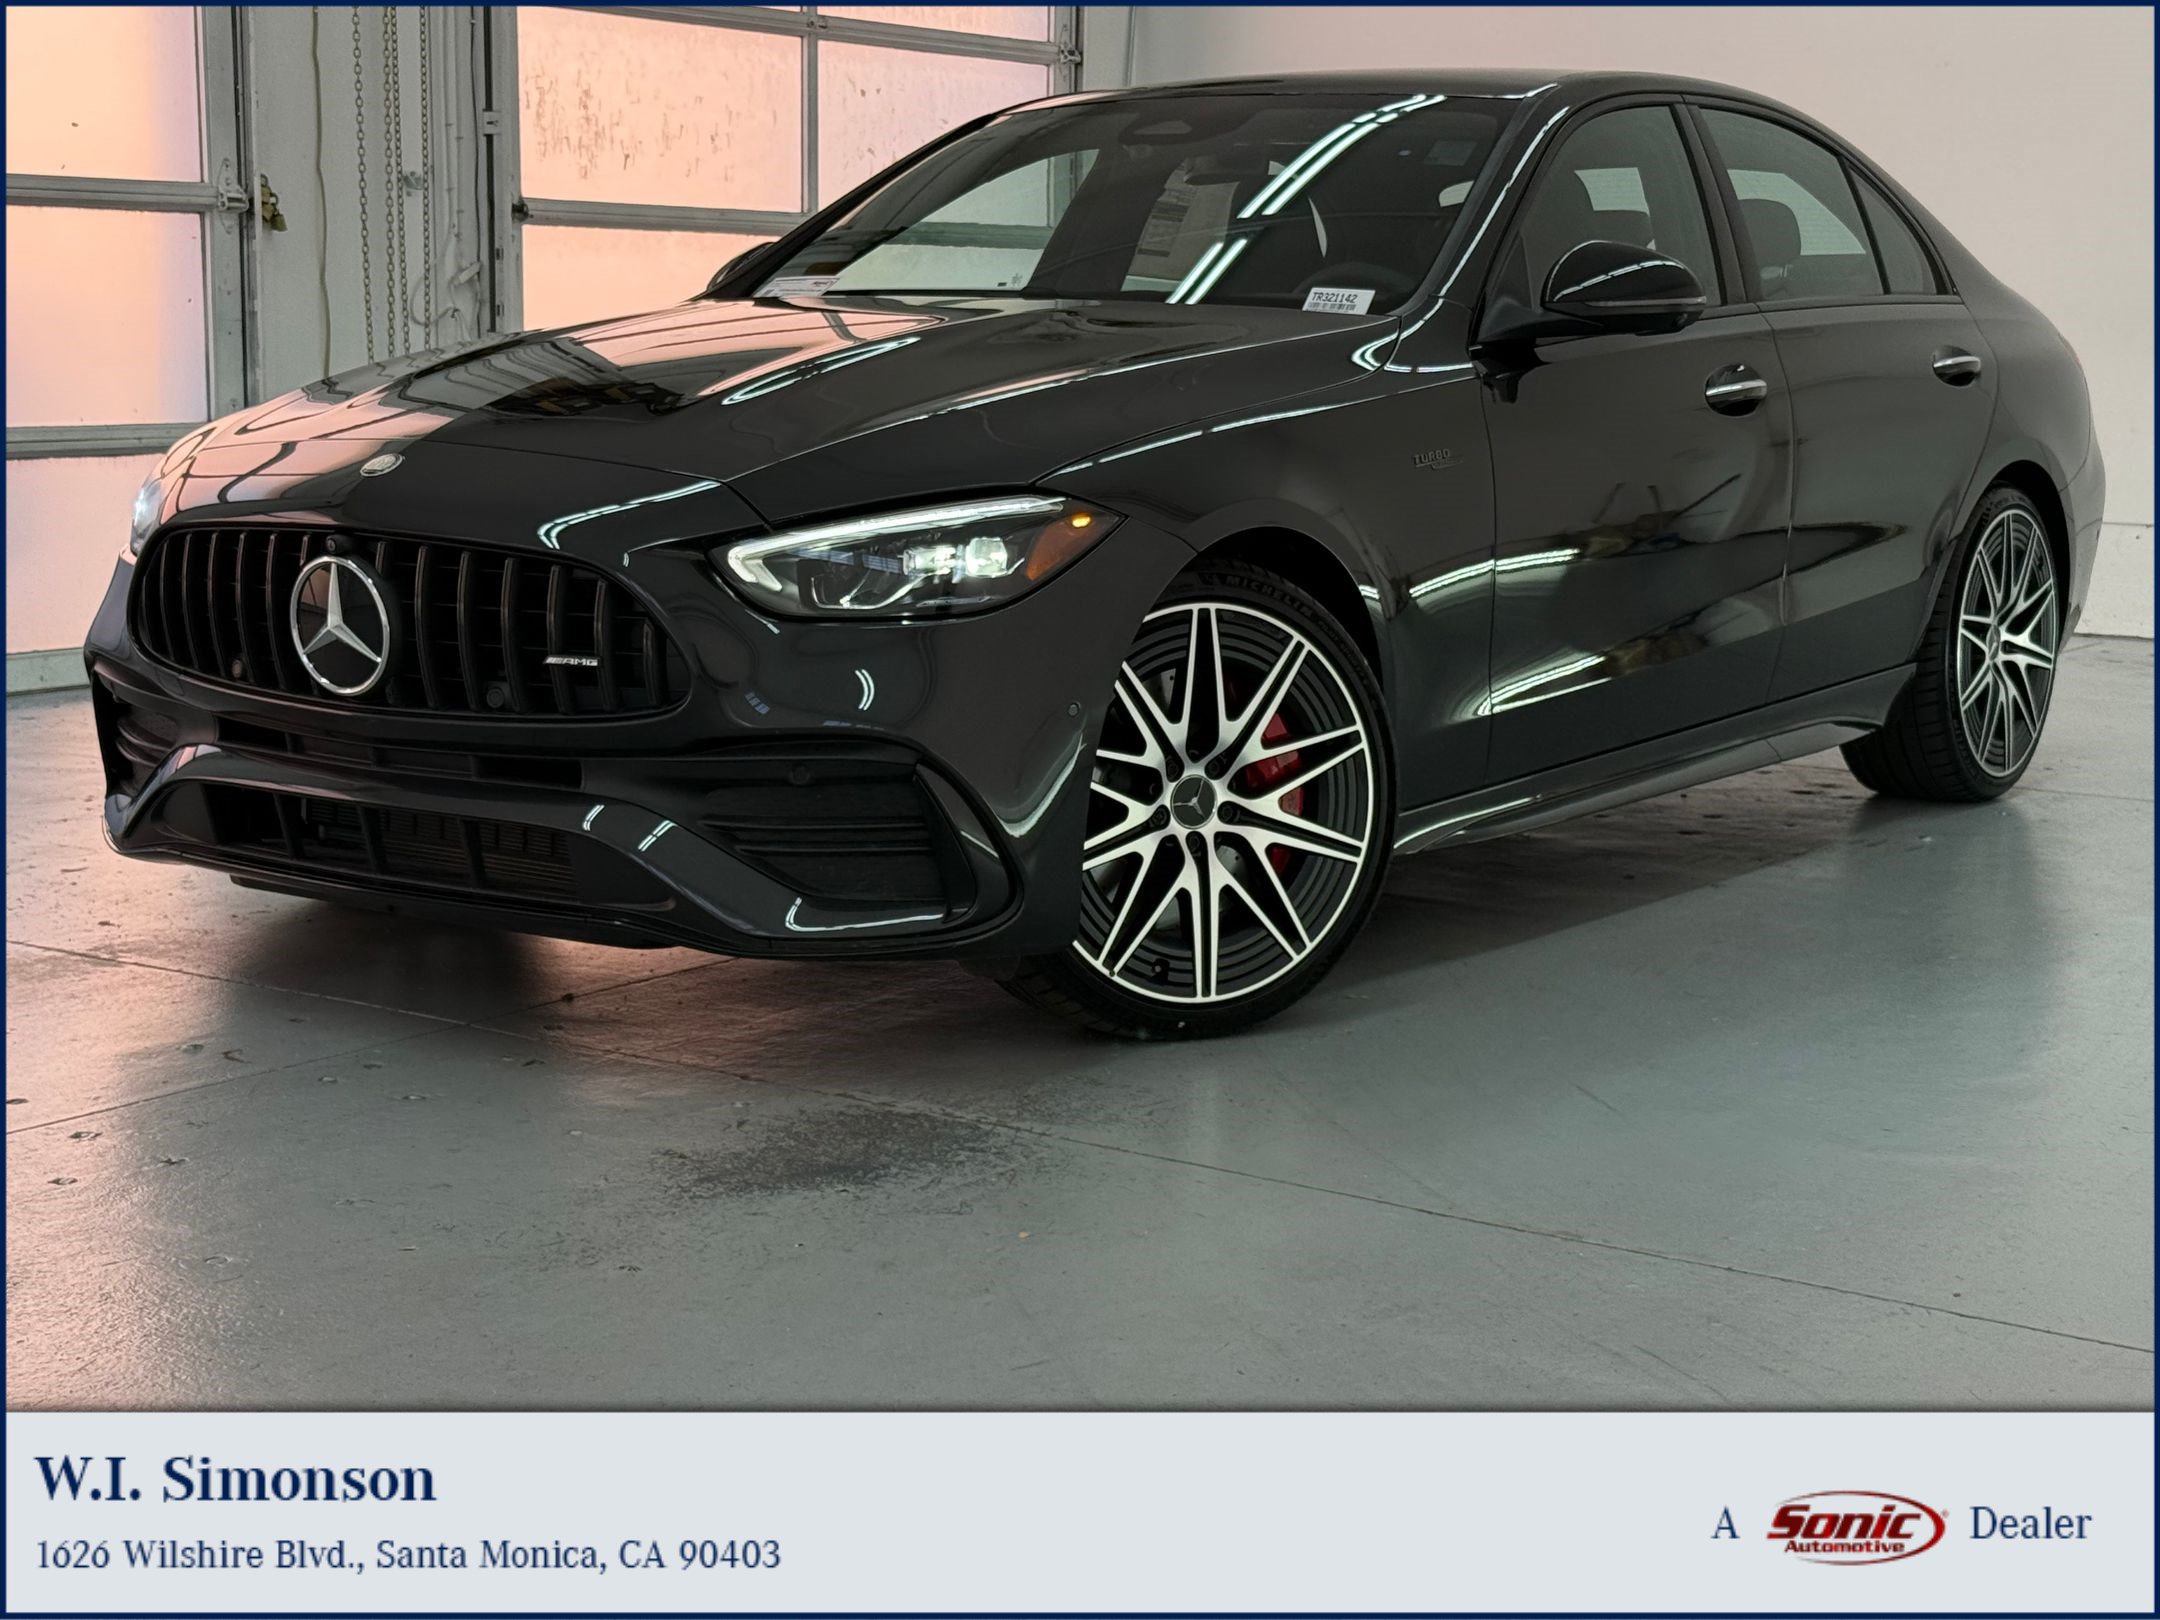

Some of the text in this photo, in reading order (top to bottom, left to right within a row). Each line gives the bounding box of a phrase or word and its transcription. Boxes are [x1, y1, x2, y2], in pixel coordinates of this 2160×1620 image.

[1312, 291, 1358, 304] TR321142
[1413, 449, 1450, 465] TURBO
[1224, 574, 1314, 619] MICHELIN
[559, 656, 599, 667] AMG
